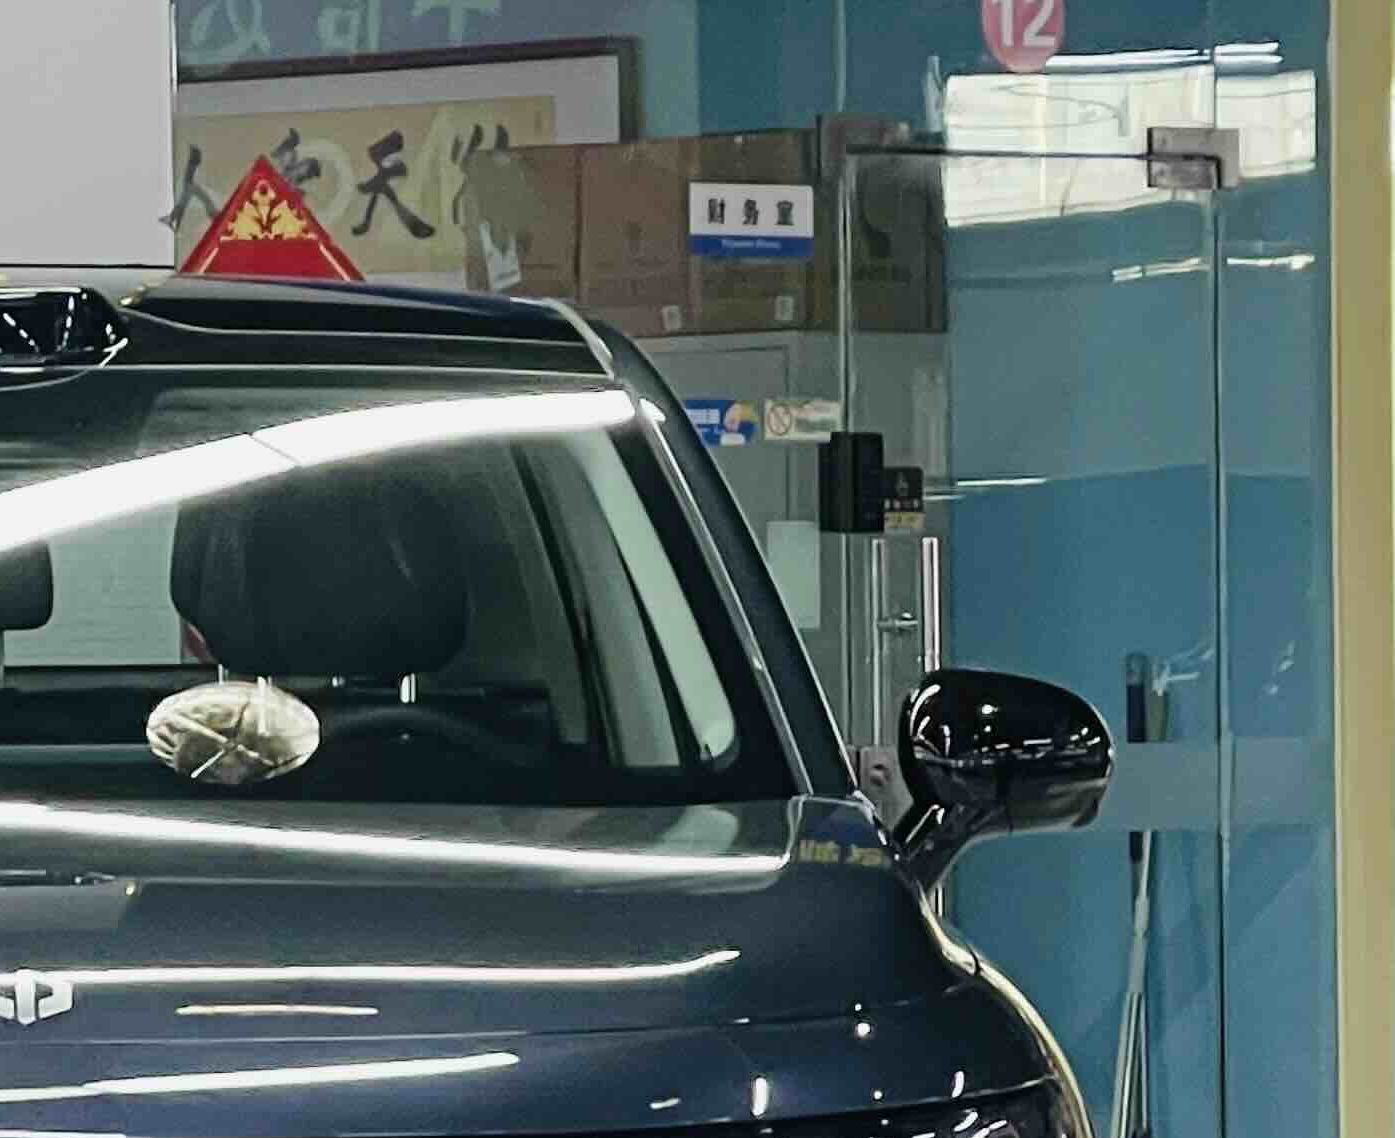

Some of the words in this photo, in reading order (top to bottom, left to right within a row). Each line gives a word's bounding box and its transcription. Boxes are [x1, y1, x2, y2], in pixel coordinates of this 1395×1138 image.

[990, 0, 1055, 47] 12
[708, 198, 794, 225] 财务室
